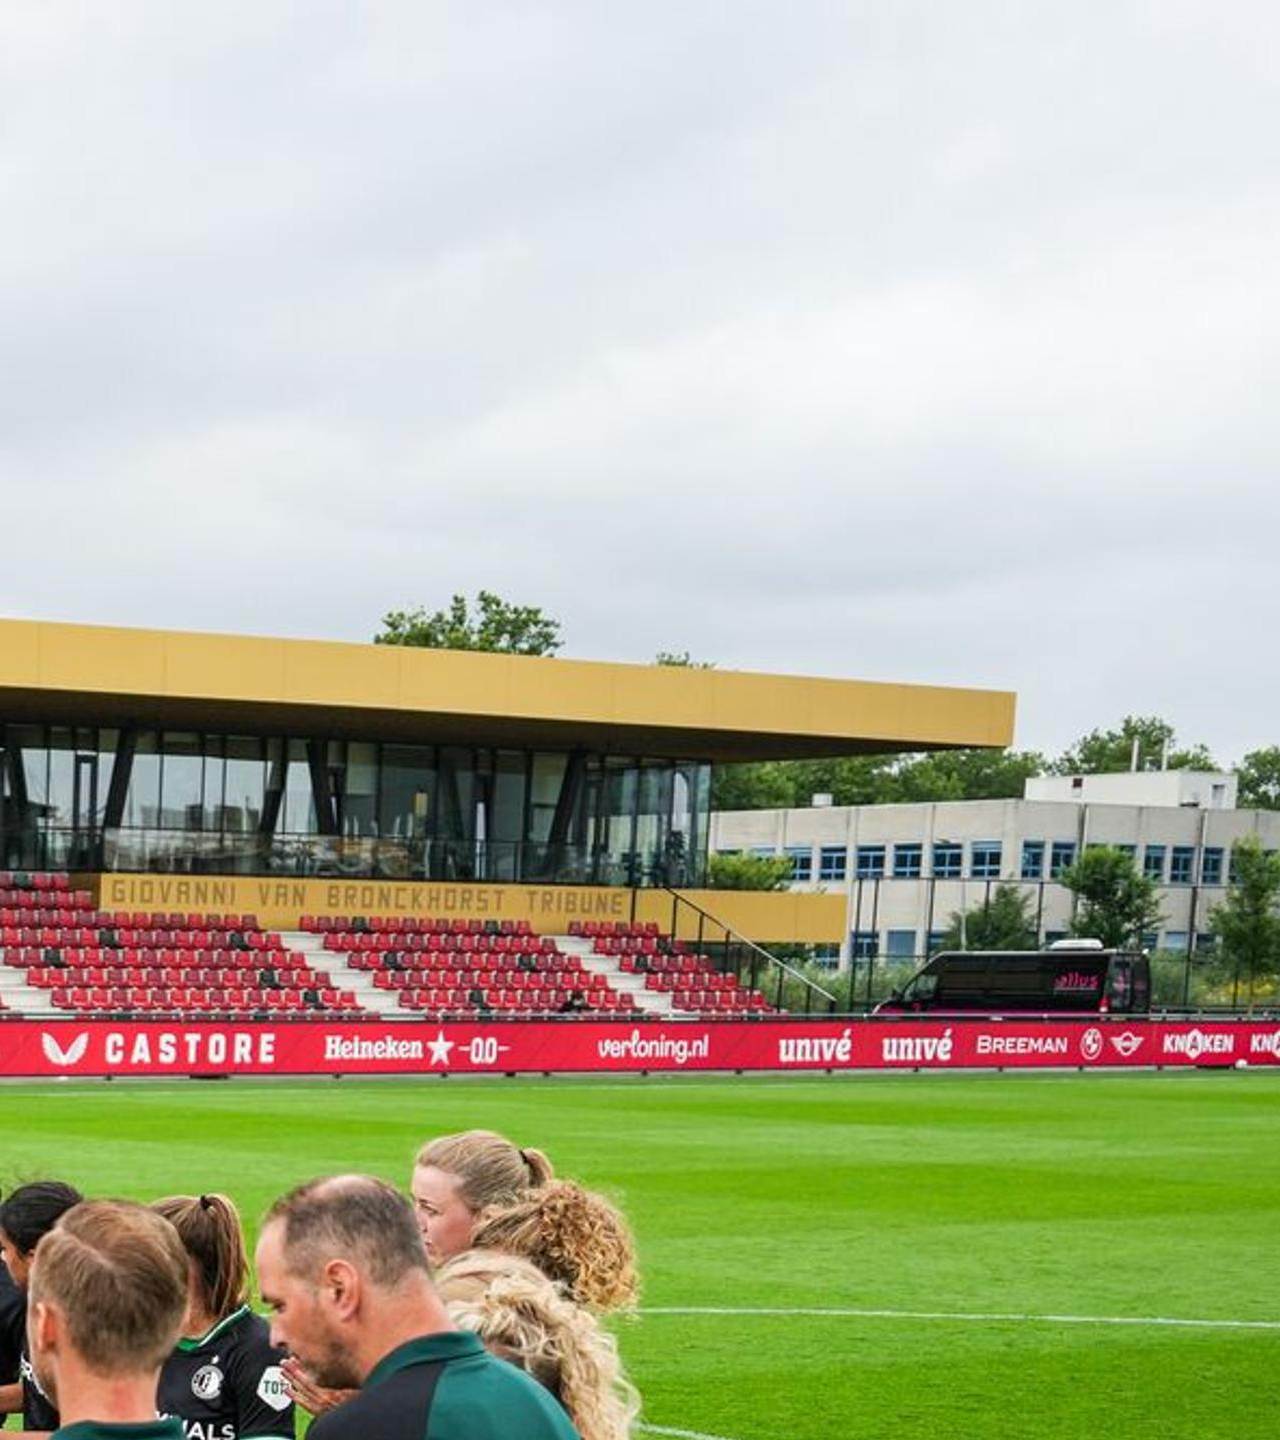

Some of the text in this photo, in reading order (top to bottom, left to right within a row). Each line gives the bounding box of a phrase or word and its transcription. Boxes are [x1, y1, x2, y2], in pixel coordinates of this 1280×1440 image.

[111, 880, 624, 915] GIOVANNI VAN BRONCKHORST TRIBUNE
[104, 1032, 276, 1064] CASTORE
[324, 1035, 424, 1060] Heineken
[778, 1028, 853, 1063] univé
[882, 1028, 953, 1062] univé
[976, 1035, 1068, 1054] BREEMAN
